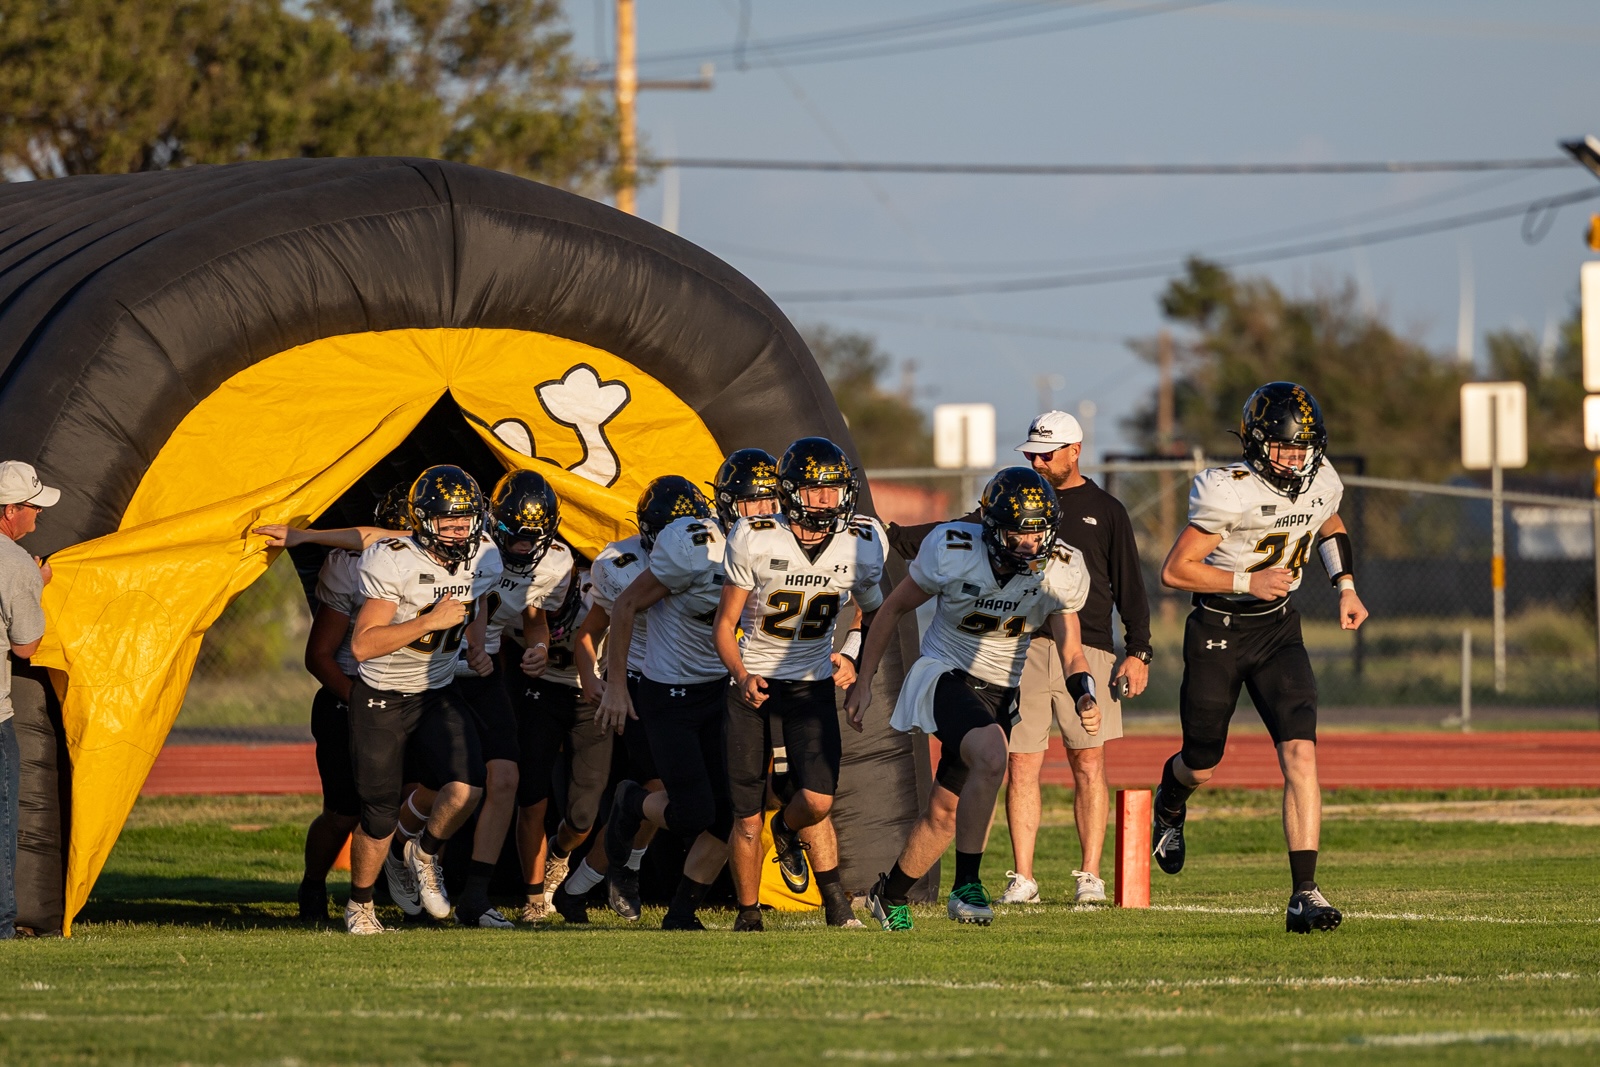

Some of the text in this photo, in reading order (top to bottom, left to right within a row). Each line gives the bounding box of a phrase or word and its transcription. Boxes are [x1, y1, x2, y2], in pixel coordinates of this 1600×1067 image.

[1274, 514, 1313, 528] HAPPY
[945, 529, 974, 551] 21
[1244, 530, 1313, 581] 24
[785, 574, 831, 588] HAPPY
[433, 584, 471, 598] HAPPY
[974, 598, 1022, 613] HAPPY
[760, 589, 840, 640] 29
